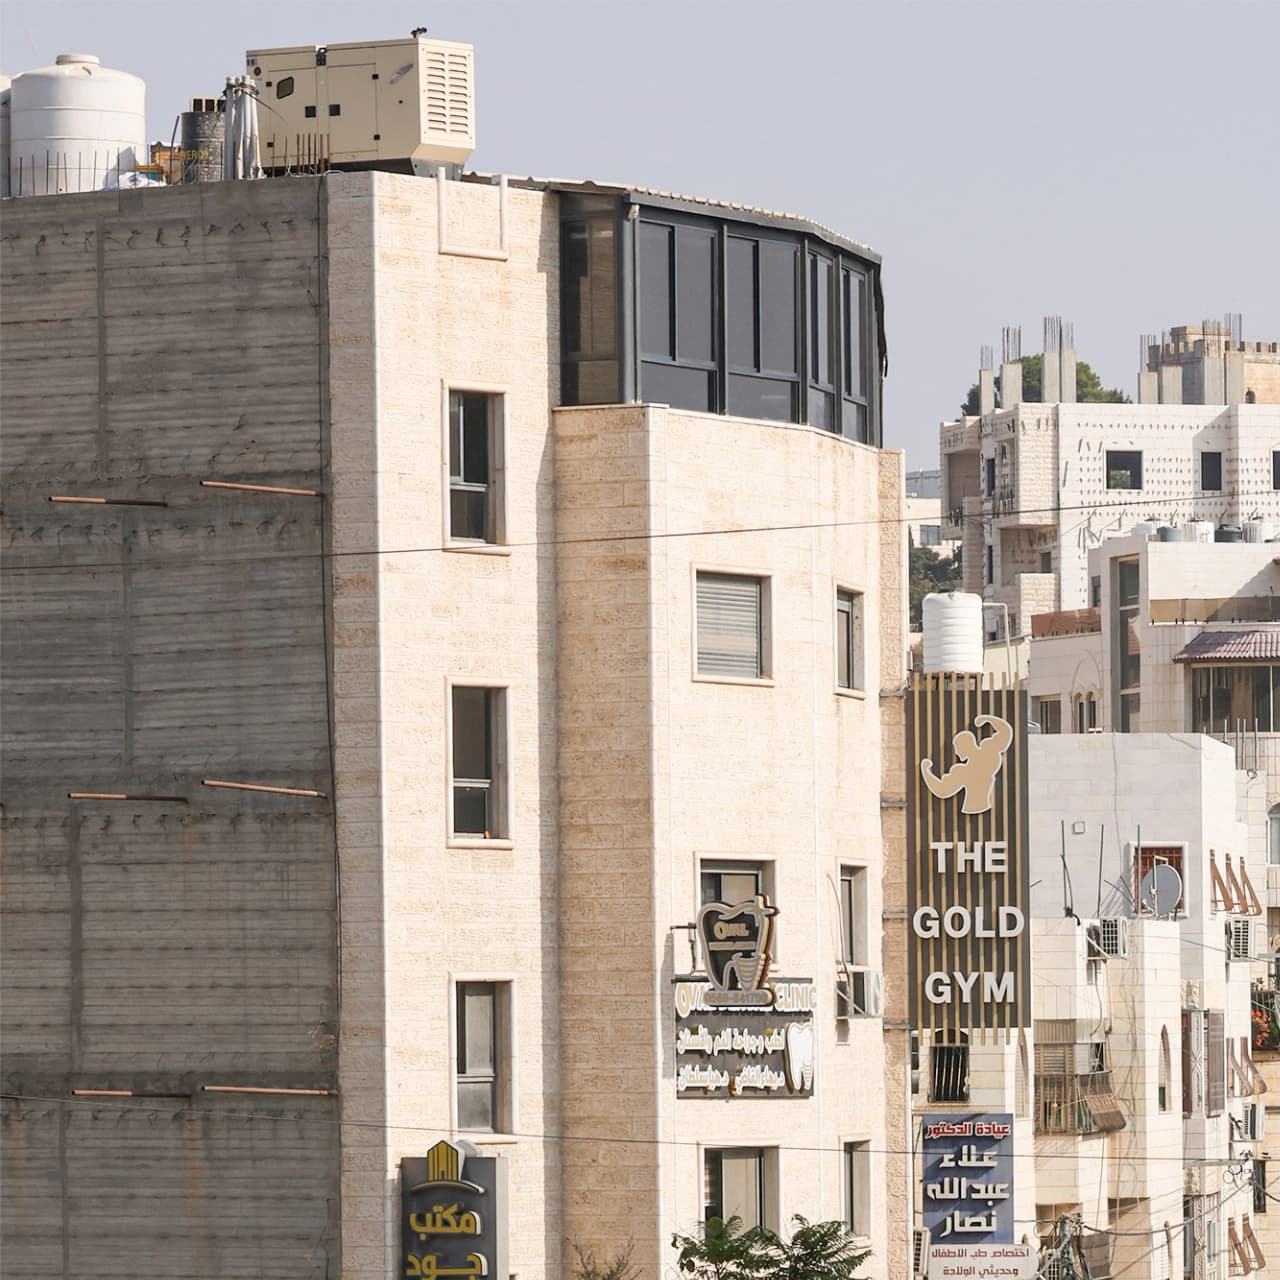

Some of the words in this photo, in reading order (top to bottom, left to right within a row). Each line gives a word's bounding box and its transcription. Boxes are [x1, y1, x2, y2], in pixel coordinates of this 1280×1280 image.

[929, 841, 1008, 873] THE
[912, 906, 1025, 938] GOLD
[925, 971, 1015, 1004] GYM
[925, 1121, 973, 1139] الدكتور
[975, 1122, 1010, 1140] عيادة
[939, 1145, 998, 1168] علاء
[410, 1203, 481, 1240] مكتب
[940, 1209, 997, 1238] نصار
[932, 1248, 967, 1258] الاطفال
[970, 1248, 988, 1259] طب
[991, 1248, 1029, 1259] اختصاص
[943, 1266, 975, 1276] الولادة
[979, 1264, 1018, 1278] وحديثي
